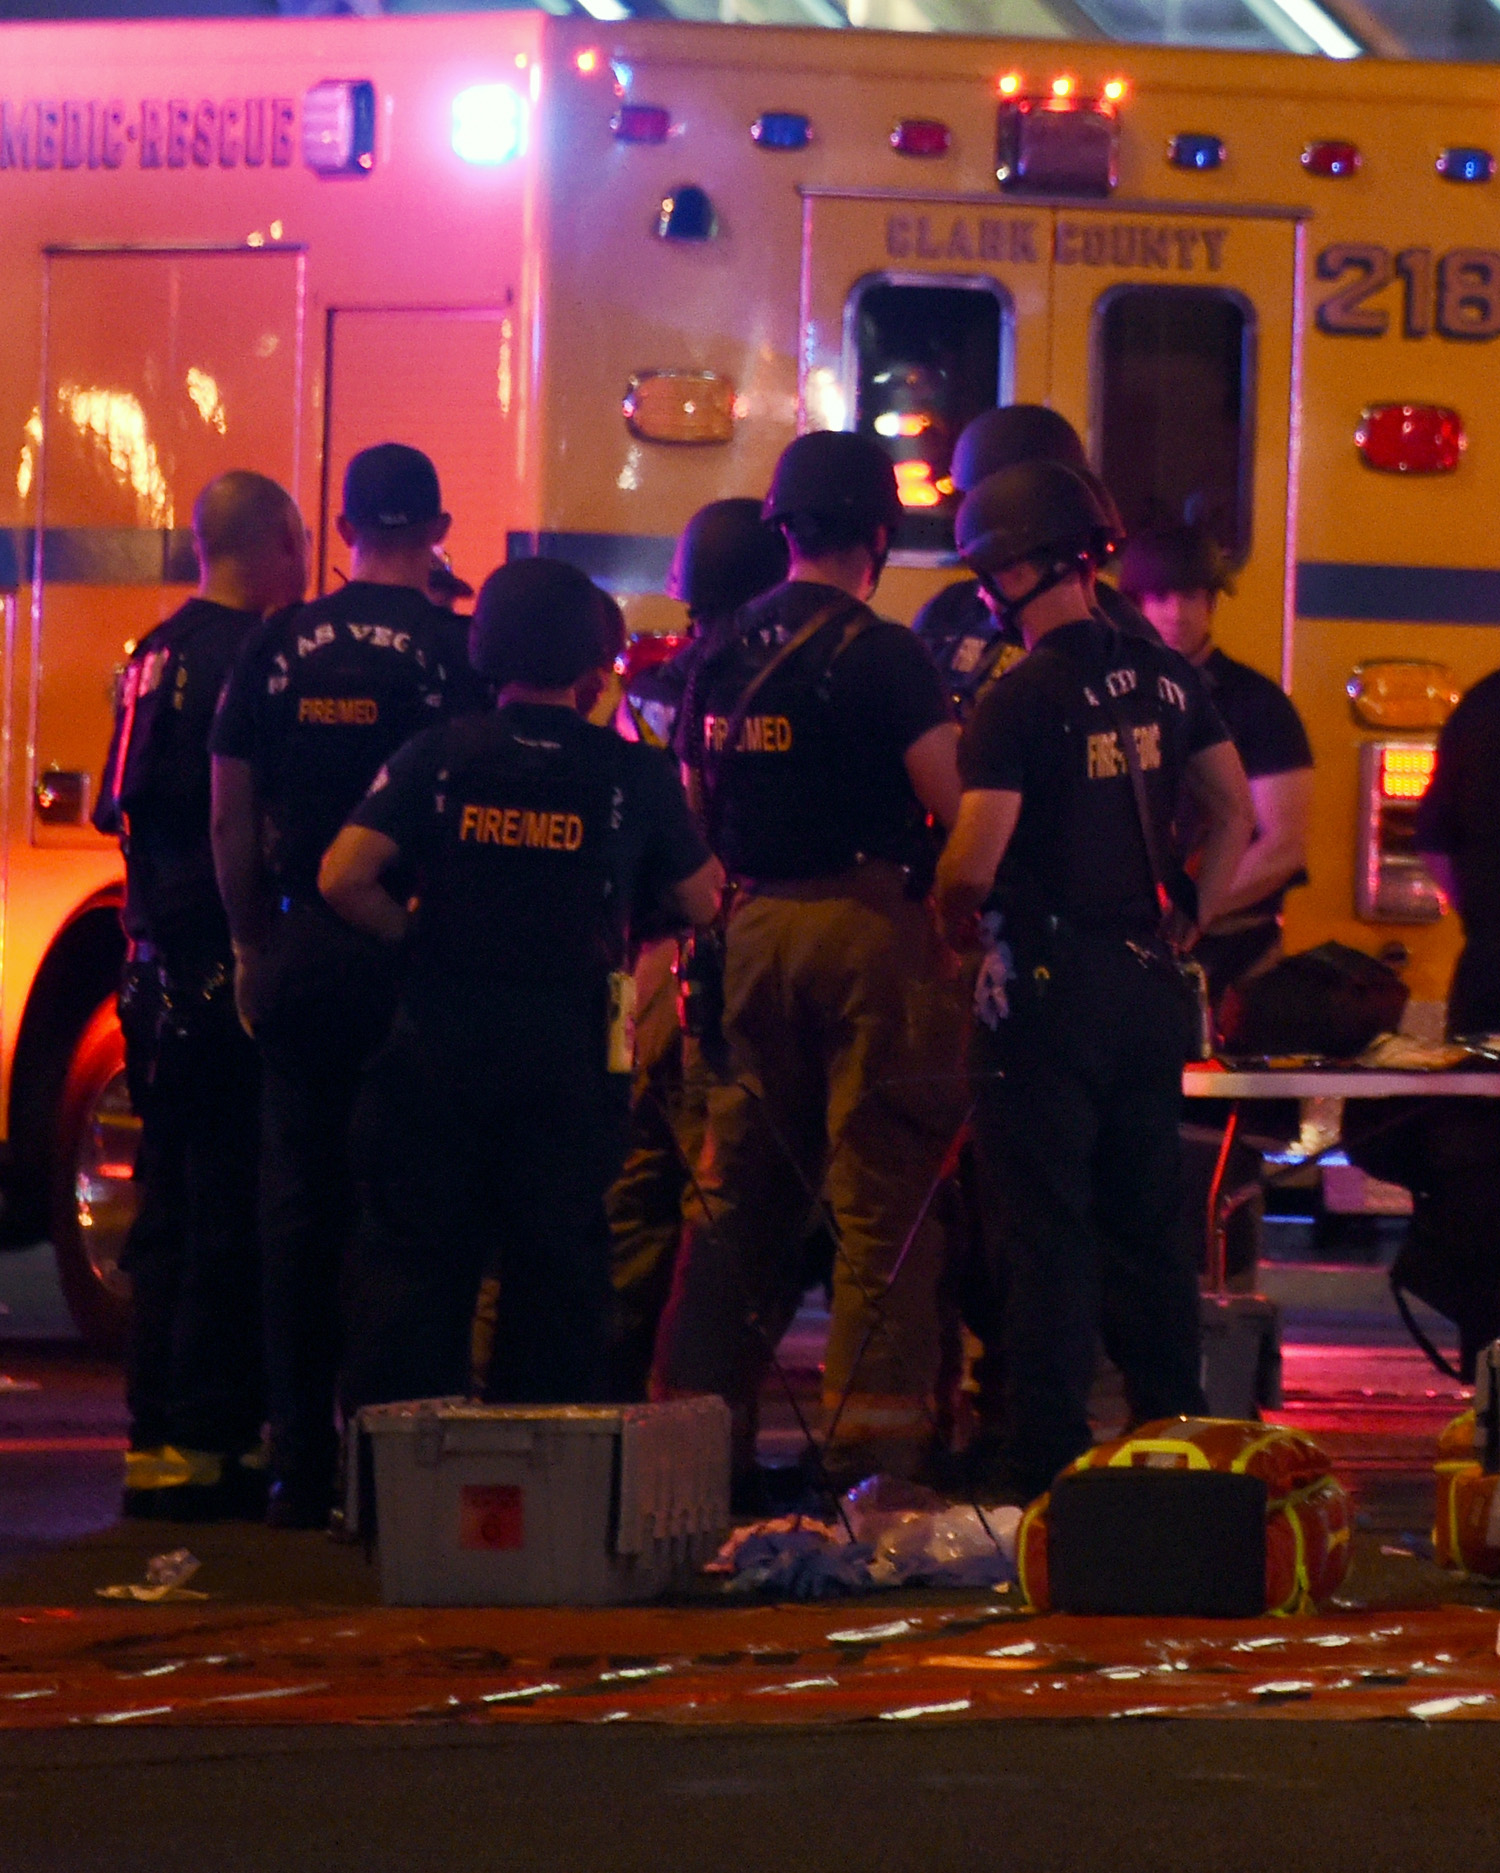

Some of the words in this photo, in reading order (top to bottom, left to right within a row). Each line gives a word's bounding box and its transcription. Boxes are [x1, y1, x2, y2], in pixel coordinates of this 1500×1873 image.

[886, 214, 1038, 263] CLARK
[1054, 220, 1226, 270] COUNTY
[460, 803, 584, 851] FIRE/MED
